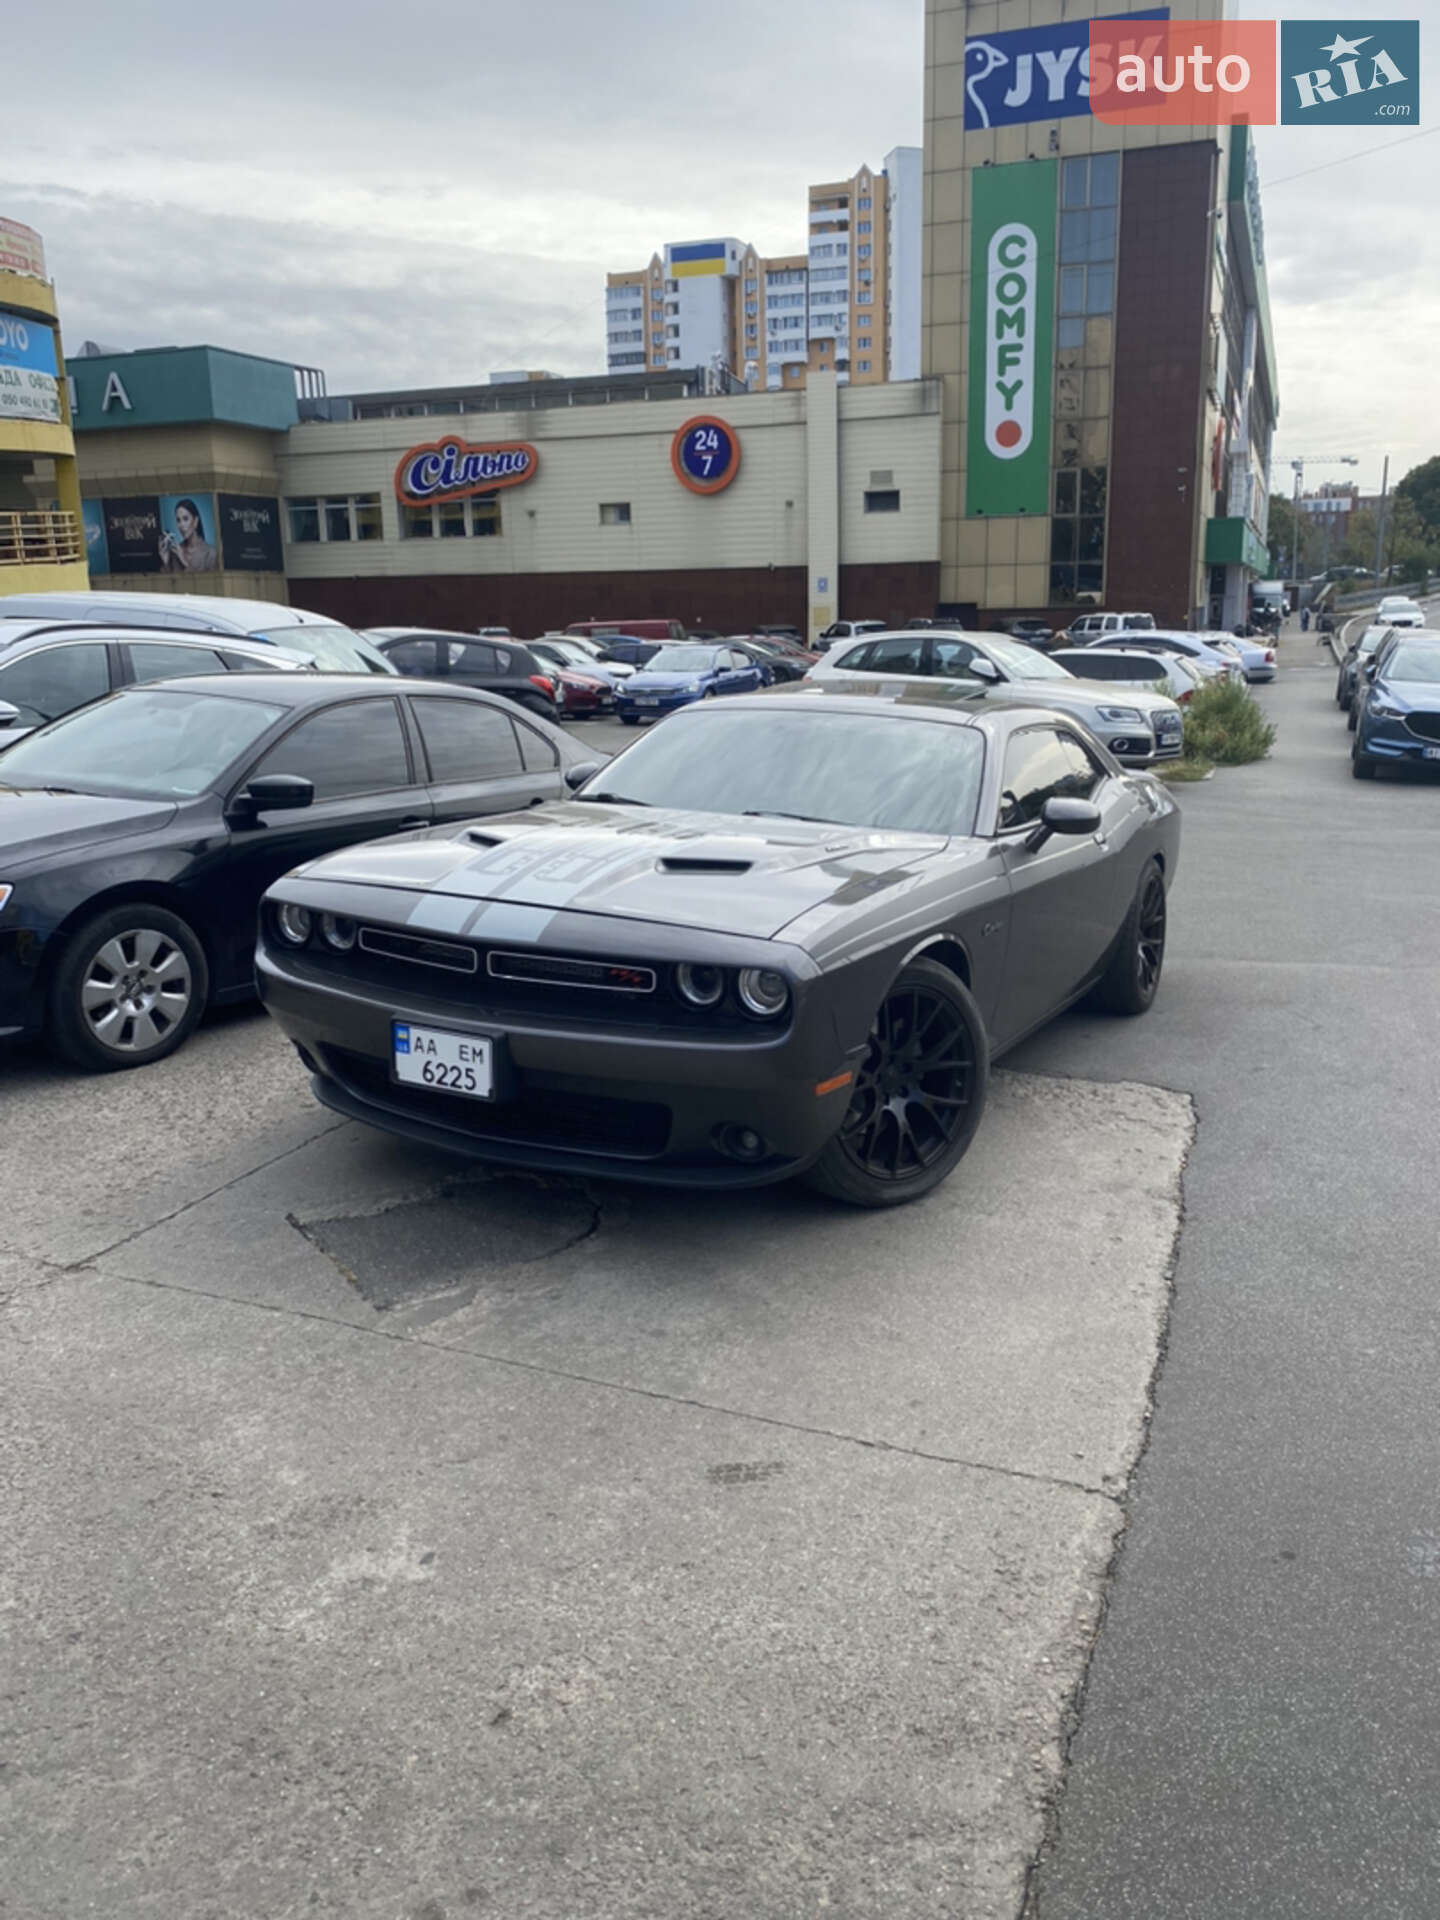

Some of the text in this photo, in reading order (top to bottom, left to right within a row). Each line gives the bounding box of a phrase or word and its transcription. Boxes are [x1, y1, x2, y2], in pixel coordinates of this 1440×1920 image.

[1003, 34, 1164, 107] JYSK
[995, 234, 1028, 412] COMFY
[695, 428, 719, 451] 24
[408, 444, 529, 494] Сільпо
[701, 455, 713, 476] 7
[414, 1036, 438, 1056] AA
[459, 1044, 484, 1065] EM
[422, 1060, 477, 1091] 6225
